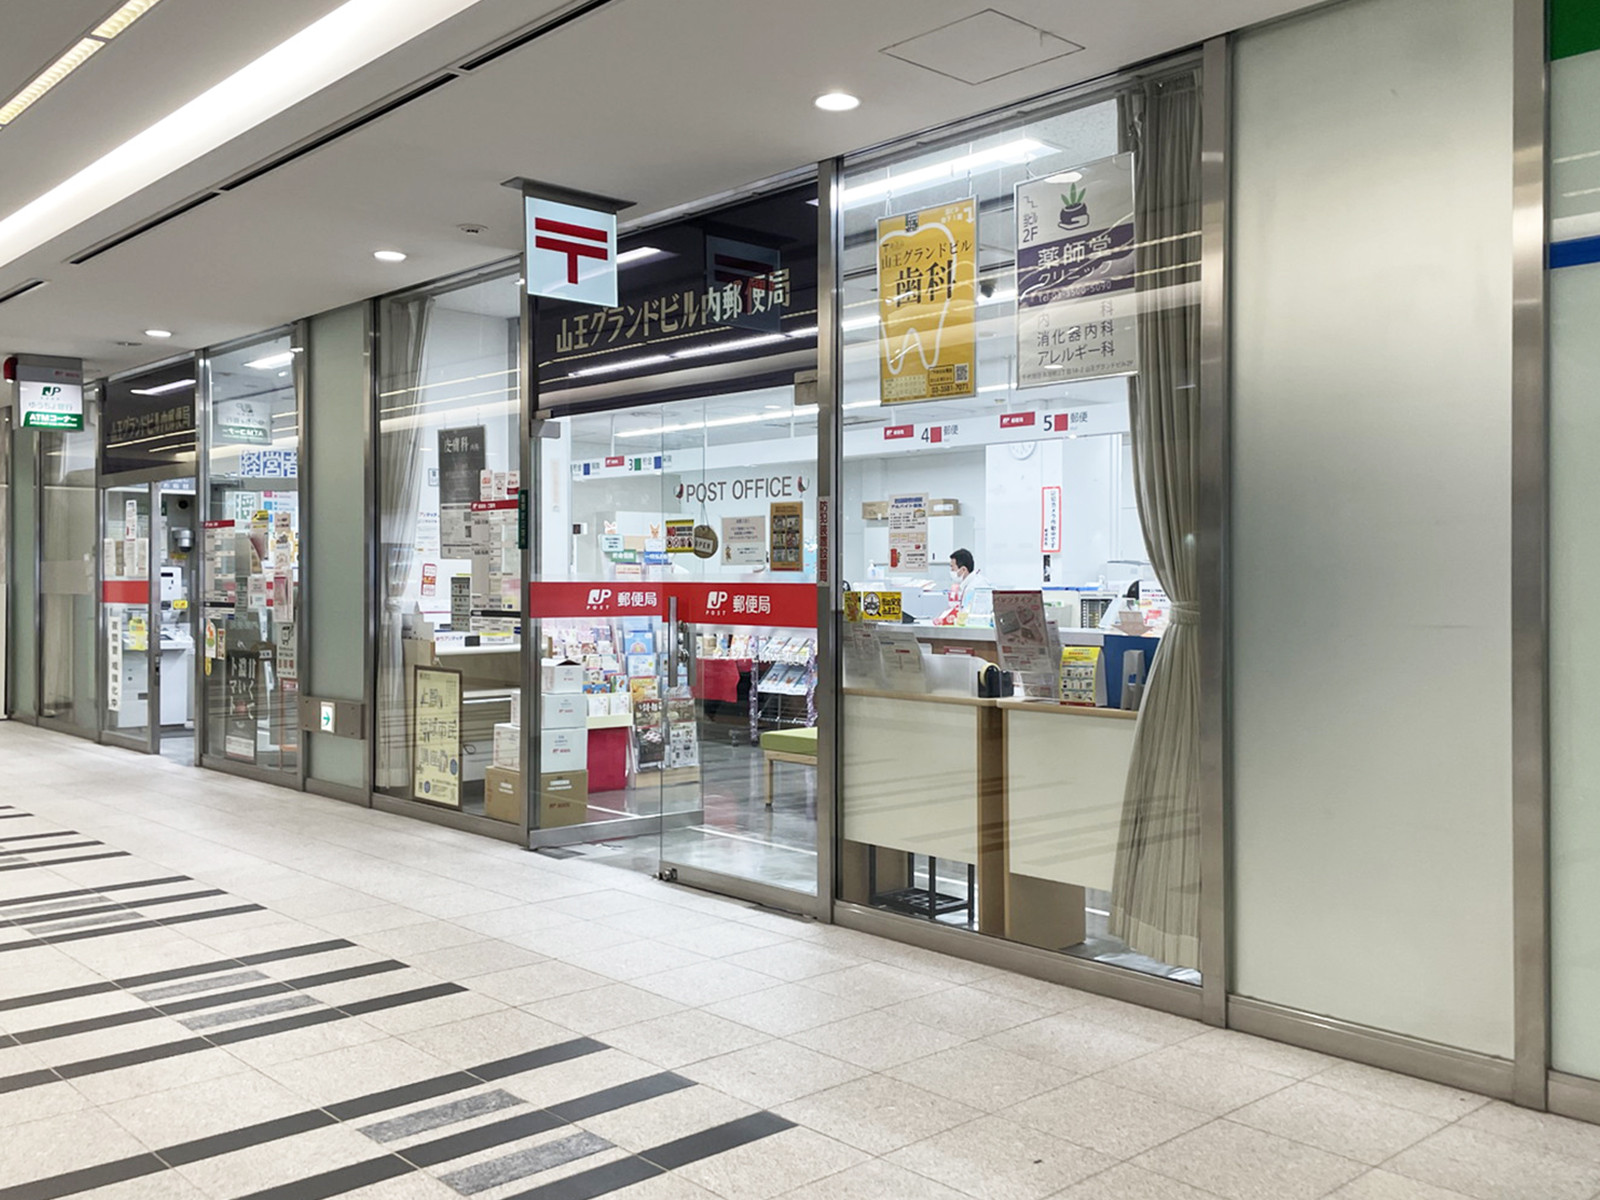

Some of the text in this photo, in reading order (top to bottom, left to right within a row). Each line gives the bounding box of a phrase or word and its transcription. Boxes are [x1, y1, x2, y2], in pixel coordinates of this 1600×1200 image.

[1023, 226, 1038, 242] 2F
[881, 240, 972, 270] 山王グランドビル
[894, 259, 957, 307] 歯科
[1038, 260, 1113, 286] クリニック
[556, 268, 790, 353] 山王グランドビル内郵便局
[1037, 319, 1114, 347] 消化器内科
[1037, 339, 1115, 366] アレルギー科
[29, 413, 78, 423] ATMコーナー
[1043, 414, 1053, 432] 5
[1070, 411, 1088, 424] 郵便
[920, 427, 930, 443] 4
[686, 476, 792, 503] POST OFFICE
[617, 591, 658, 607] 郵便局
[732, 594, 771, 614] 郵便局
